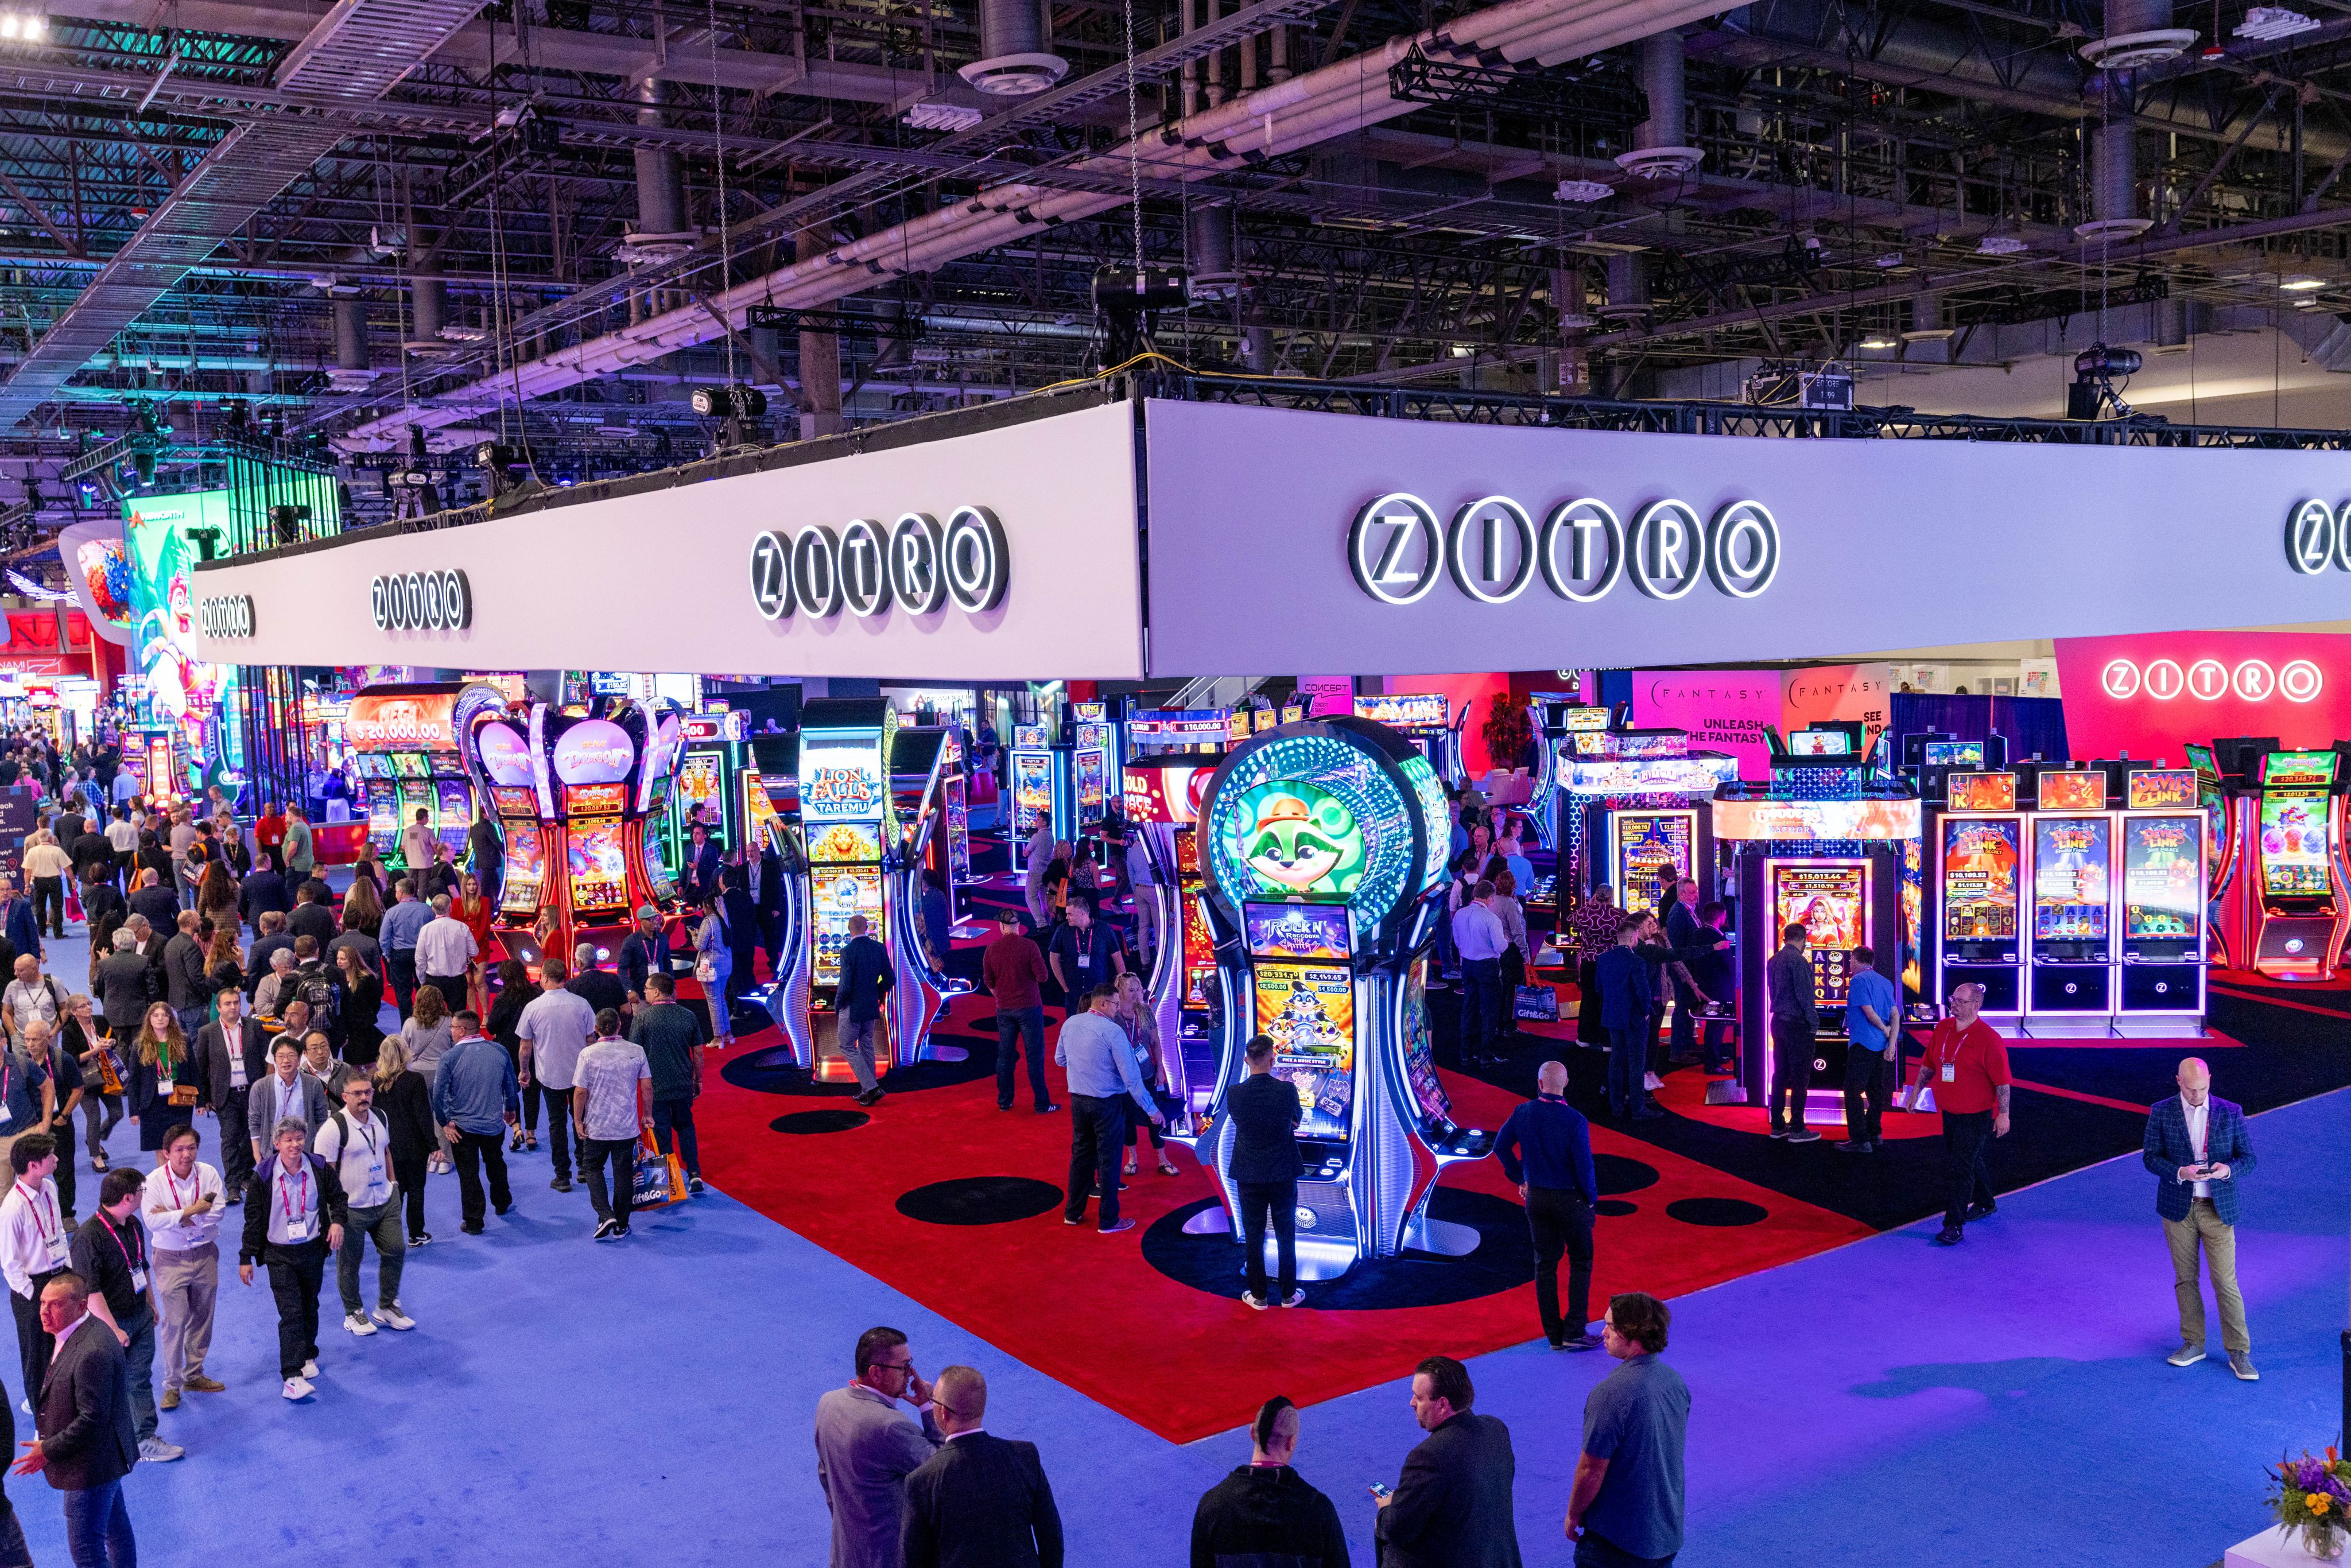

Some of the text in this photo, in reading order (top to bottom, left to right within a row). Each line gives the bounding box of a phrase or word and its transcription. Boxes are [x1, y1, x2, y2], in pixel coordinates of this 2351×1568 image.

[1359, 492, 1780, 604] ZITRO
[750, 505, 995, 620] ZITRO
[371, 568, 463, 631] ZITRO
[201, 594, 250, 638] ZITRO
[2102, 659, 2323, 703] ZITRO
[1663, 689, 1762, 699] FANTASY
[1799, 682, 1881, 697] FANTASY
[1864, 711, 1881, 722] SEE
[356, 723, 440, 740] $ 20,000.00
[1184, 723, 1221, 731] $10,000.00
[1704, 719, 1764, 731] UNLEASH
[1708, 731, 1764, 744] FANTASY
[820, 767, 864, 783] LION
[2132, 773, 2195, 793] DEVIL'S
[809, 782, 872, 802] FALLS
[2148, 791, 2182, 804] LINK
[817, 802, 868, 813] TAREMU
[1960, 829, 2003, 842] DEVIL'S
[2050, 828, 2094, 841] DEVIL'S
[2140, 827, 2184, 840] DEVIL'S
[1969, 841, 1997, 850] LINK
[2058, 839, 2088, 849] LINK
[2149, 838, 2178, 848] LINK
[1267, 919, 1311, 941] ROCK
[1814, 951, 1825, 961] A
[1814, 964, 1825, 974] K
[1814, 976, 1825, 986] K
[1814, 988, 1825, 999] Q
[1833, 989, 1838, 999] J
[1518, 1009, 1550, 1019] Gift&Go
[633, 1189, 661, 1205] Gift&Go
